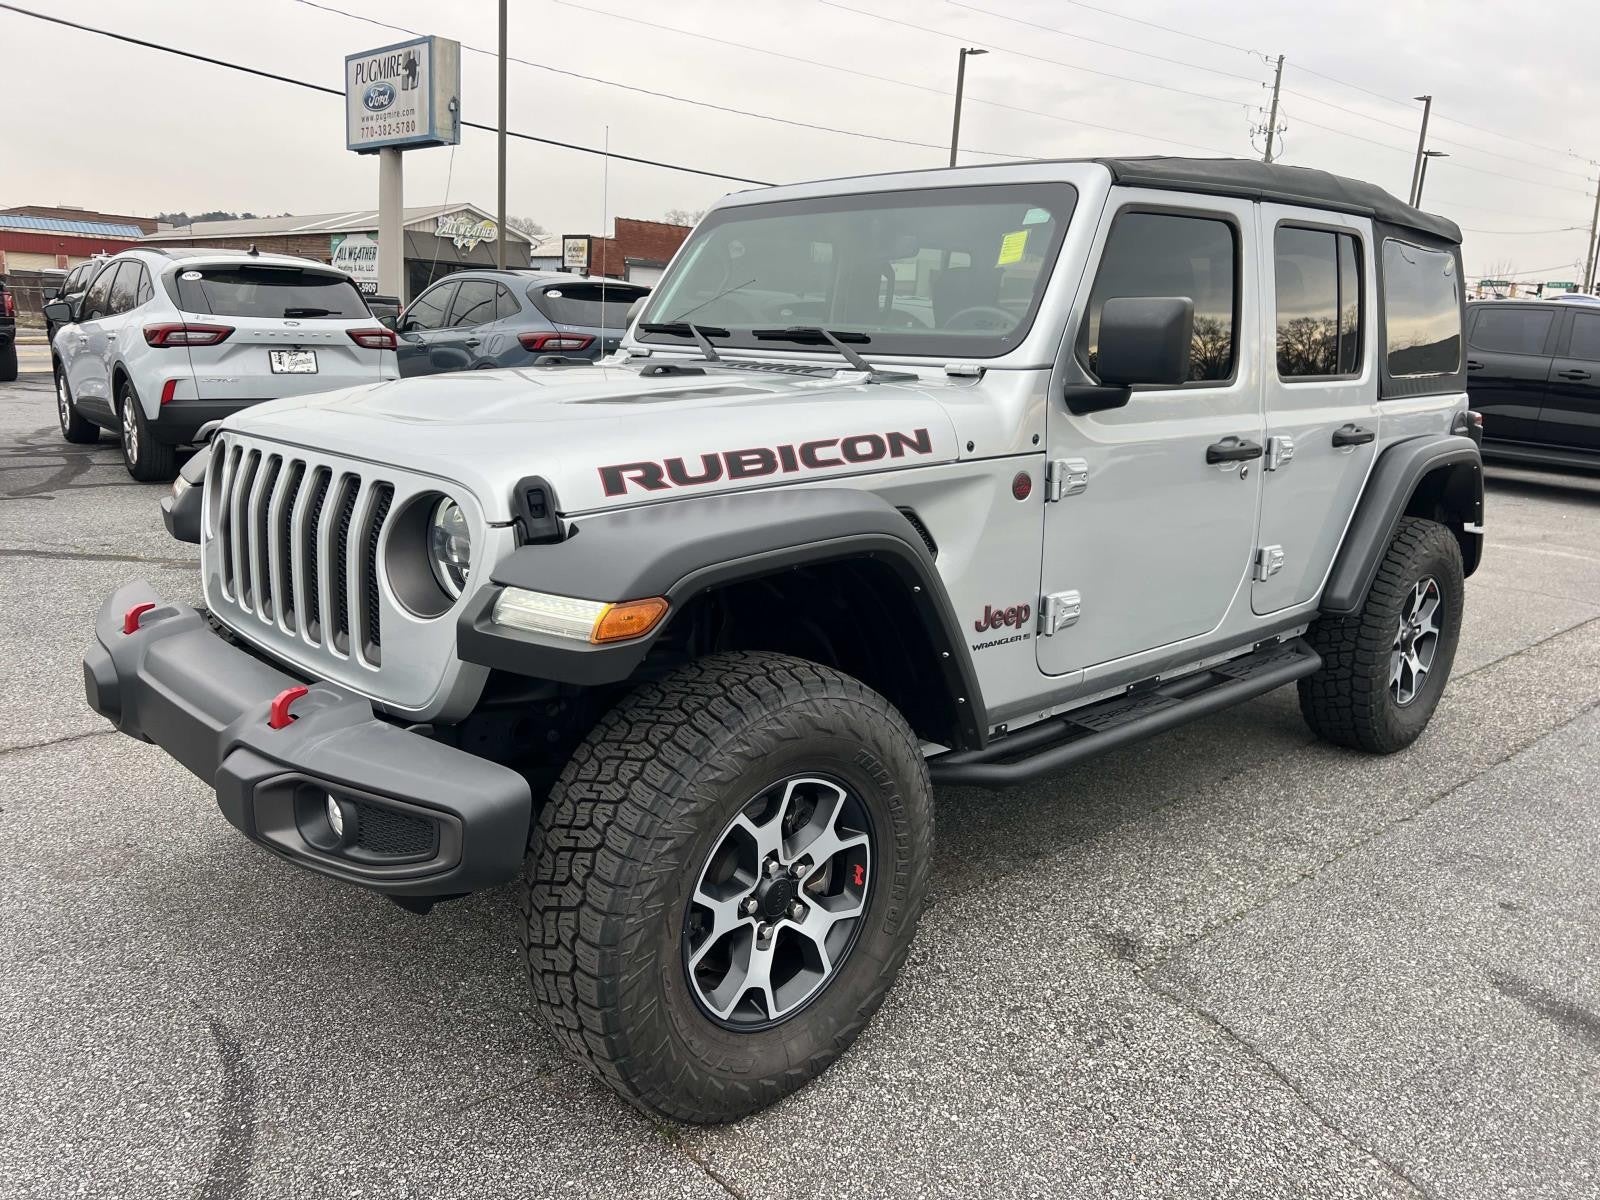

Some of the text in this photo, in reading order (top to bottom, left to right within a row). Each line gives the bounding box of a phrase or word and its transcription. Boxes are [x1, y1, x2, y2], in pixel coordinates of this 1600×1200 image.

[355, 54, 402, 85] PUGMIRE
[368, 87, 390, 107] Ford
[361, 107, 415, 122] www.pugmire.com
[361, 120, 416, 139] 770-382-5780
[442, 224, 496, 238] ALL WEATHER
[335, 246, 377, 262] ALL WEATHER
[366, 264, 375, 272] LLC
[597, 428, 933, 498] RUBICON
[974, 603, 1031, 633] Jeep
[972, 634, 1022, 652] WRANGLER
